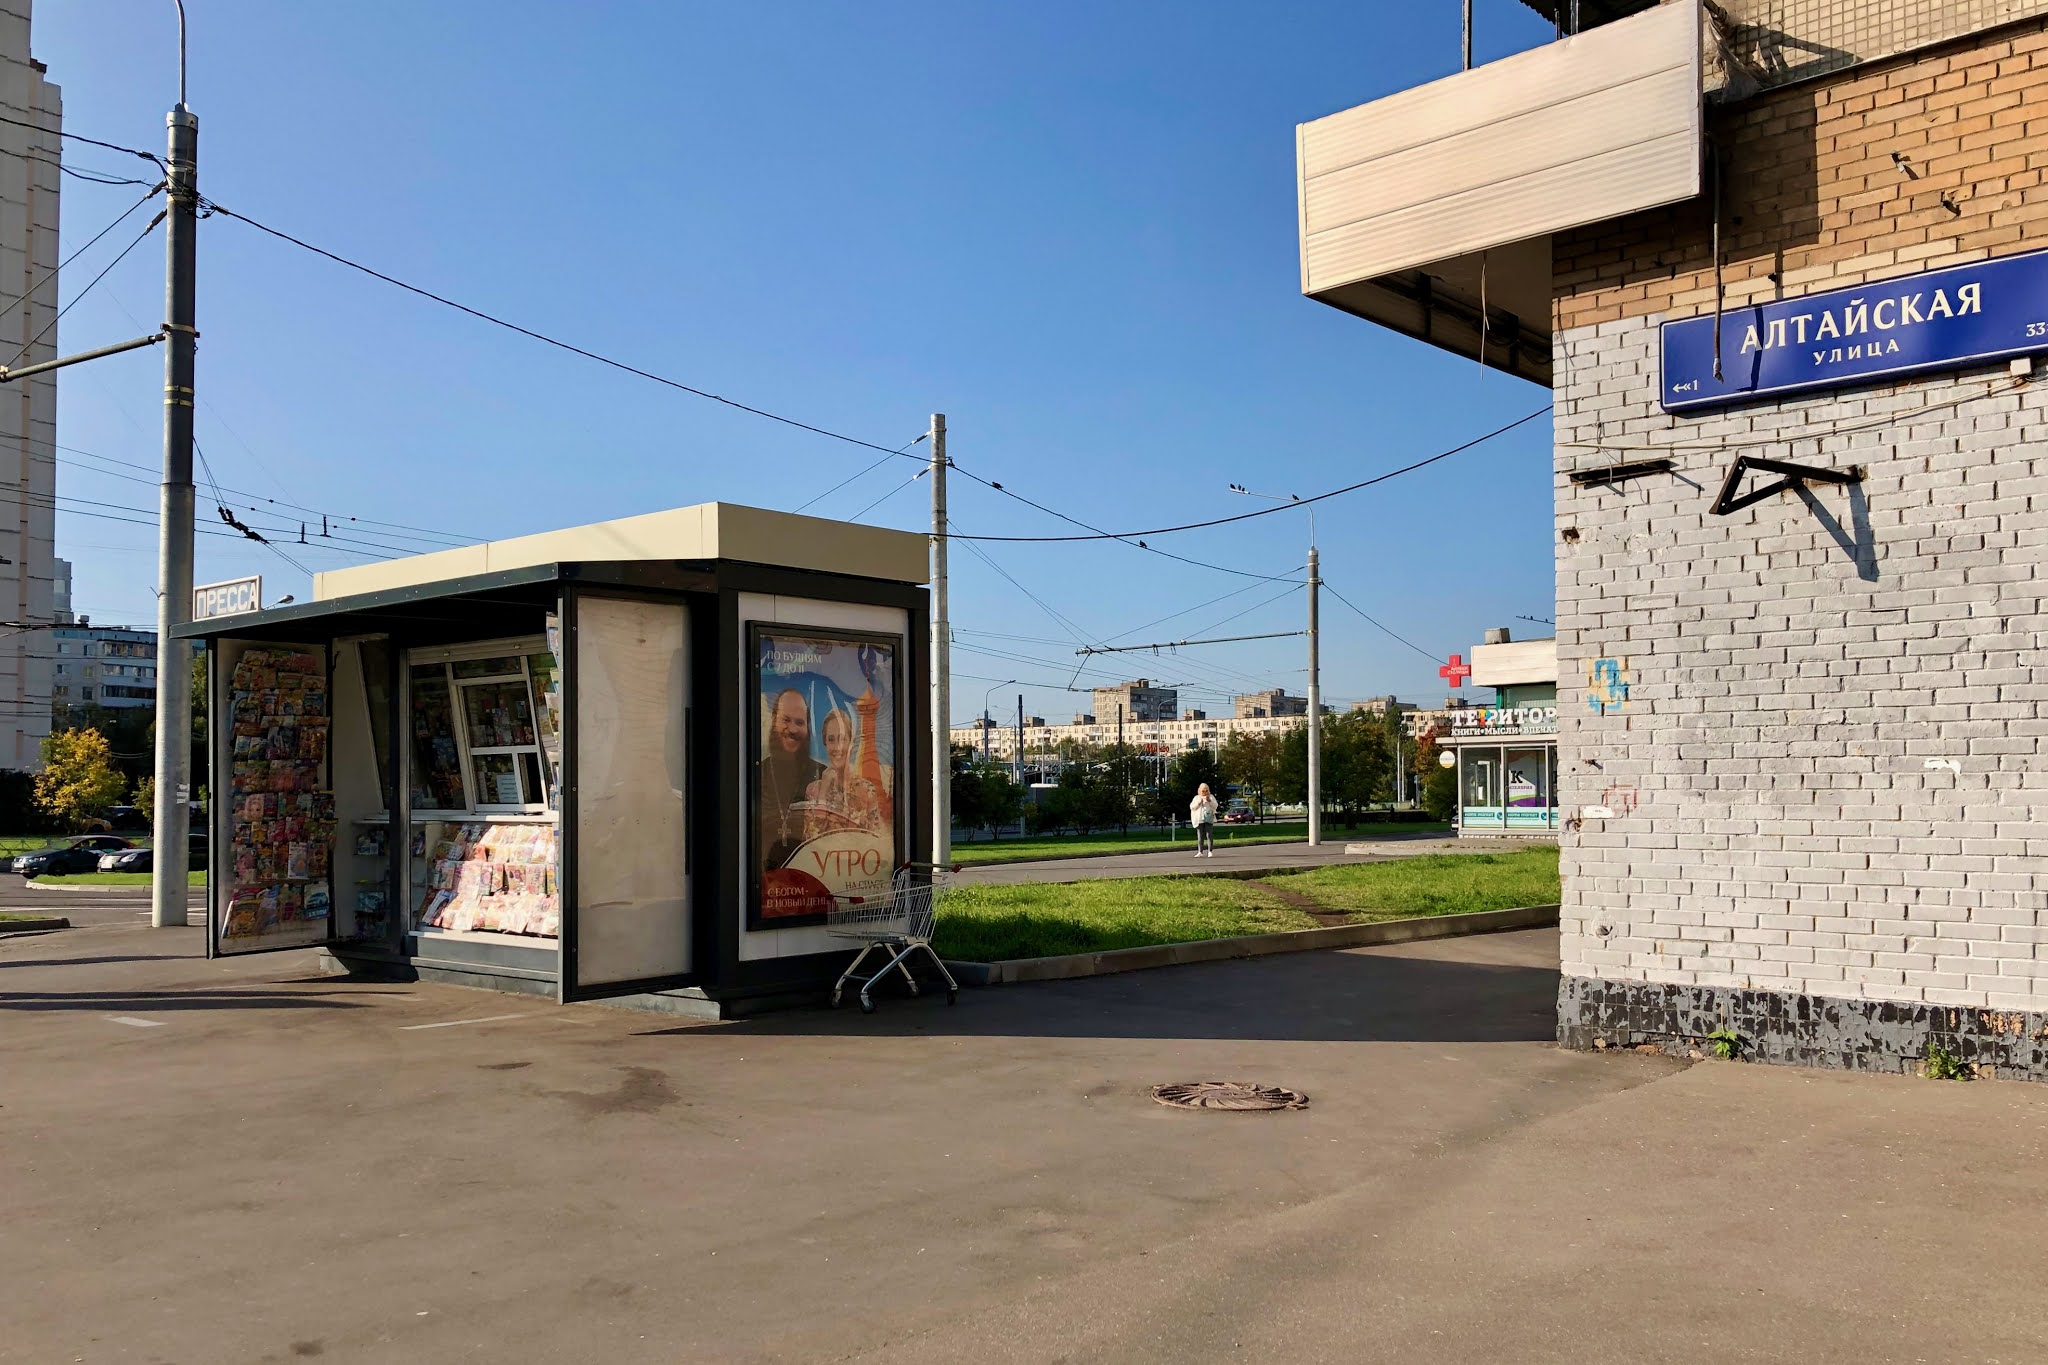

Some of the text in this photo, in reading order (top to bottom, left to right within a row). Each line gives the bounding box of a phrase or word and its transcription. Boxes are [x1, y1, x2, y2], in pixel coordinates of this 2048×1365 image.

[1740, 283, 1982, 354] АЛТАЙСКАЯ
[2026, 321, 2048, 337] 33
[1813, 338, 1900, 366] УЛИЦА
[1692, 379, 1698, 391] 1
[196, 581, 258, 618] ПРЕССА
[767, 650, 822, 664] ПО БУДНЯМ
[783, 663, 797, 674] ДО
[1451, 728, 1481, 736] КНИГИ
[1485, 727, 1519, 735] МЫСЛИ
[811, 848, 881, 878] УТРО
[845, 881, 856, 889] НА
[767, 887, 775, 897] С
[766, 898, 774, 908] В
